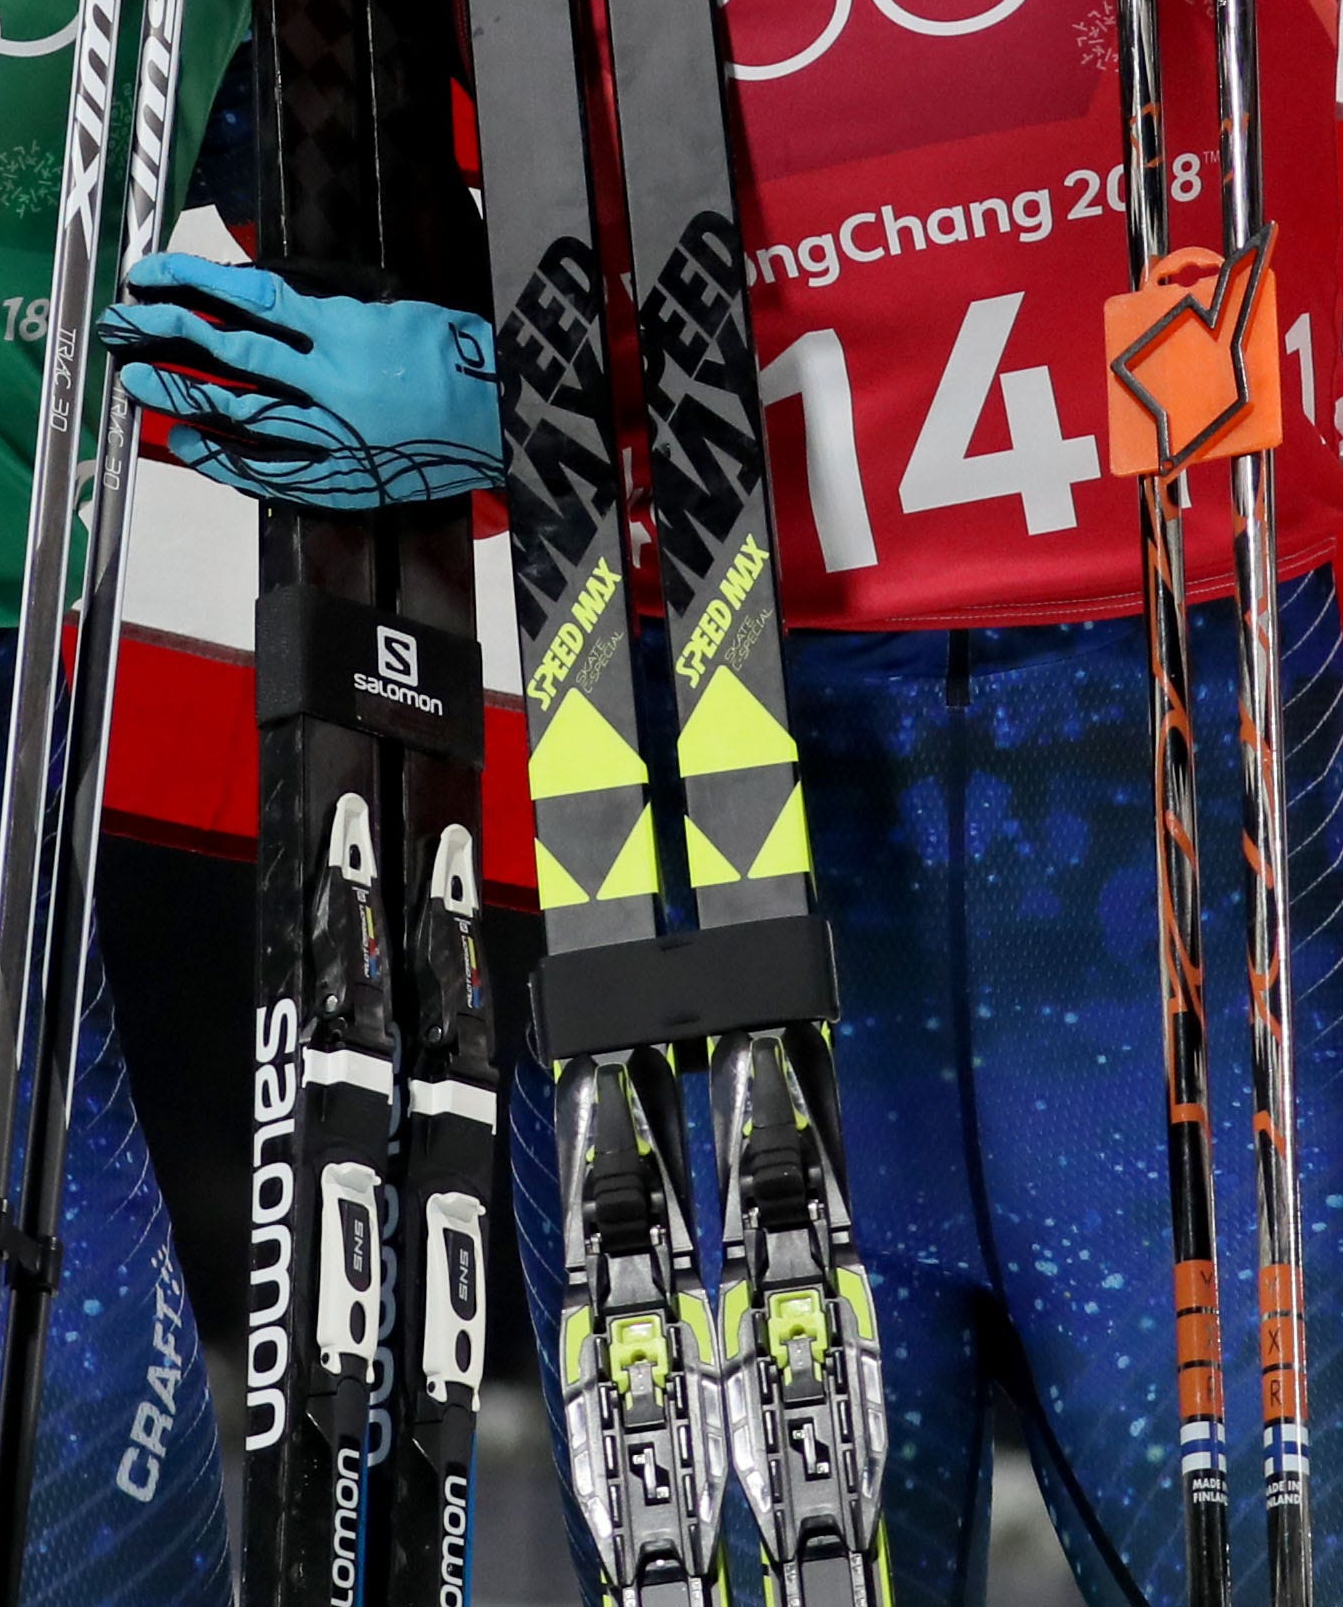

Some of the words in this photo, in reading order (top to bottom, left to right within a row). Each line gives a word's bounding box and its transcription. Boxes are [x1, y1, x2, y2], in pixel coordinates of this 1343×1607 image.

[746, 188, 1054, 288] ngChang
[760, 291, 1101, 574] 14
[526, 621, 585, 712] SPEED
[570, 556, 623, 634] MAX
[674, 598, 733, 690] SPEED
[718, 532, 771, 611] MAX
[352, 1217, 364, 1272] SNS
[458, 1247, 471, 1302] SNS
[116, 1300, 185, 1503] CRAFT
[1192, 1477, 1221, 1491] MADE
[1266, 1480, 1286, 1497] ADE
